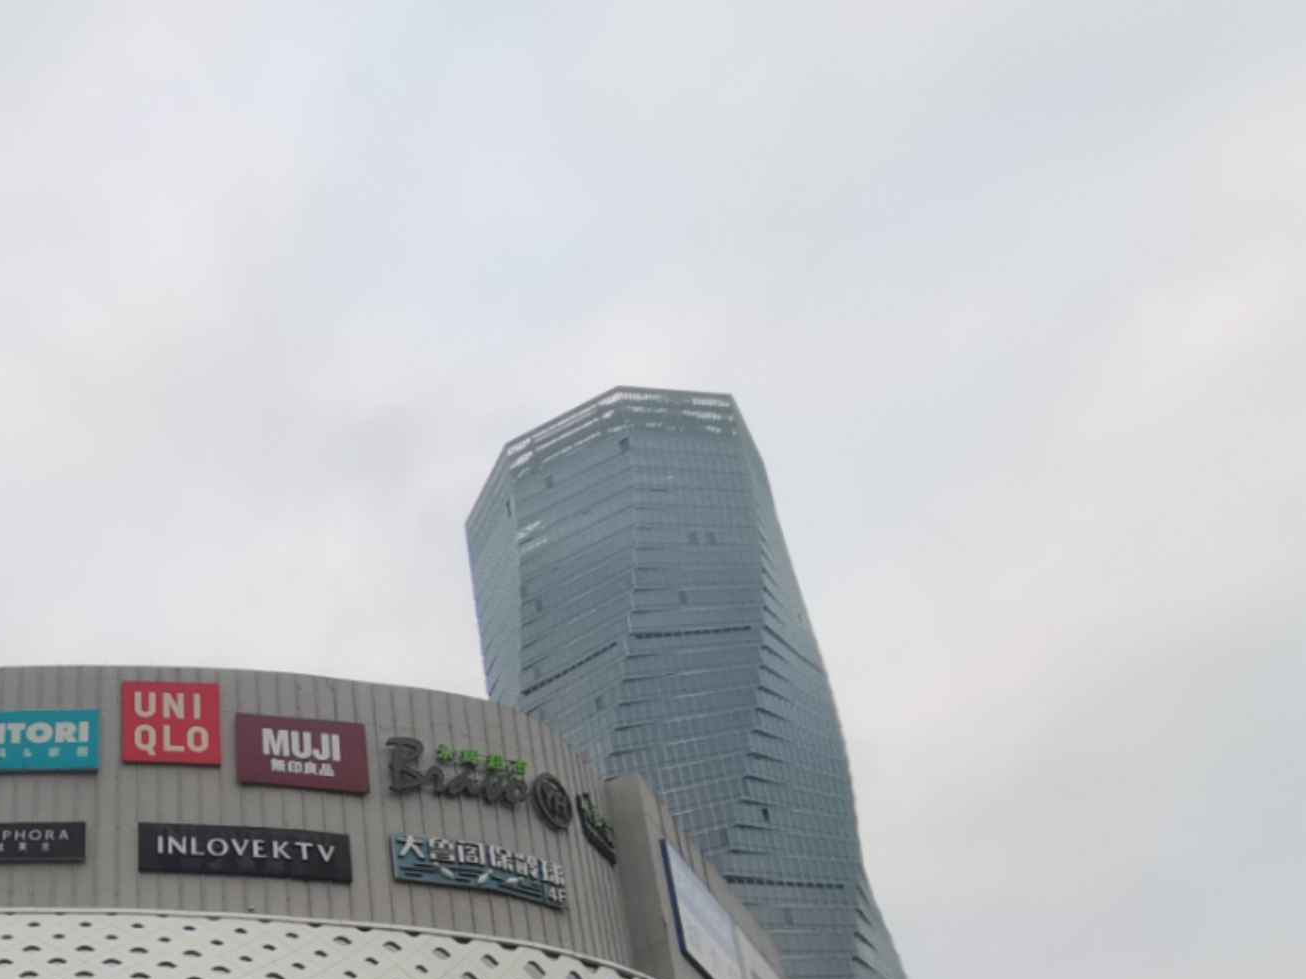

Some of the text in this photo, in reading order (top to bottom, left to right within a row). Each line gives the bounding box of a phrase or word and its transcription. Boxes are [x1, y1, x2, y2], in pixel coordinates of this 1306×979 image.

[134, 691, 202, 719] UNI
[134, 724, 209, 756] QLO
[261, 728, 341, 761] MUJI
